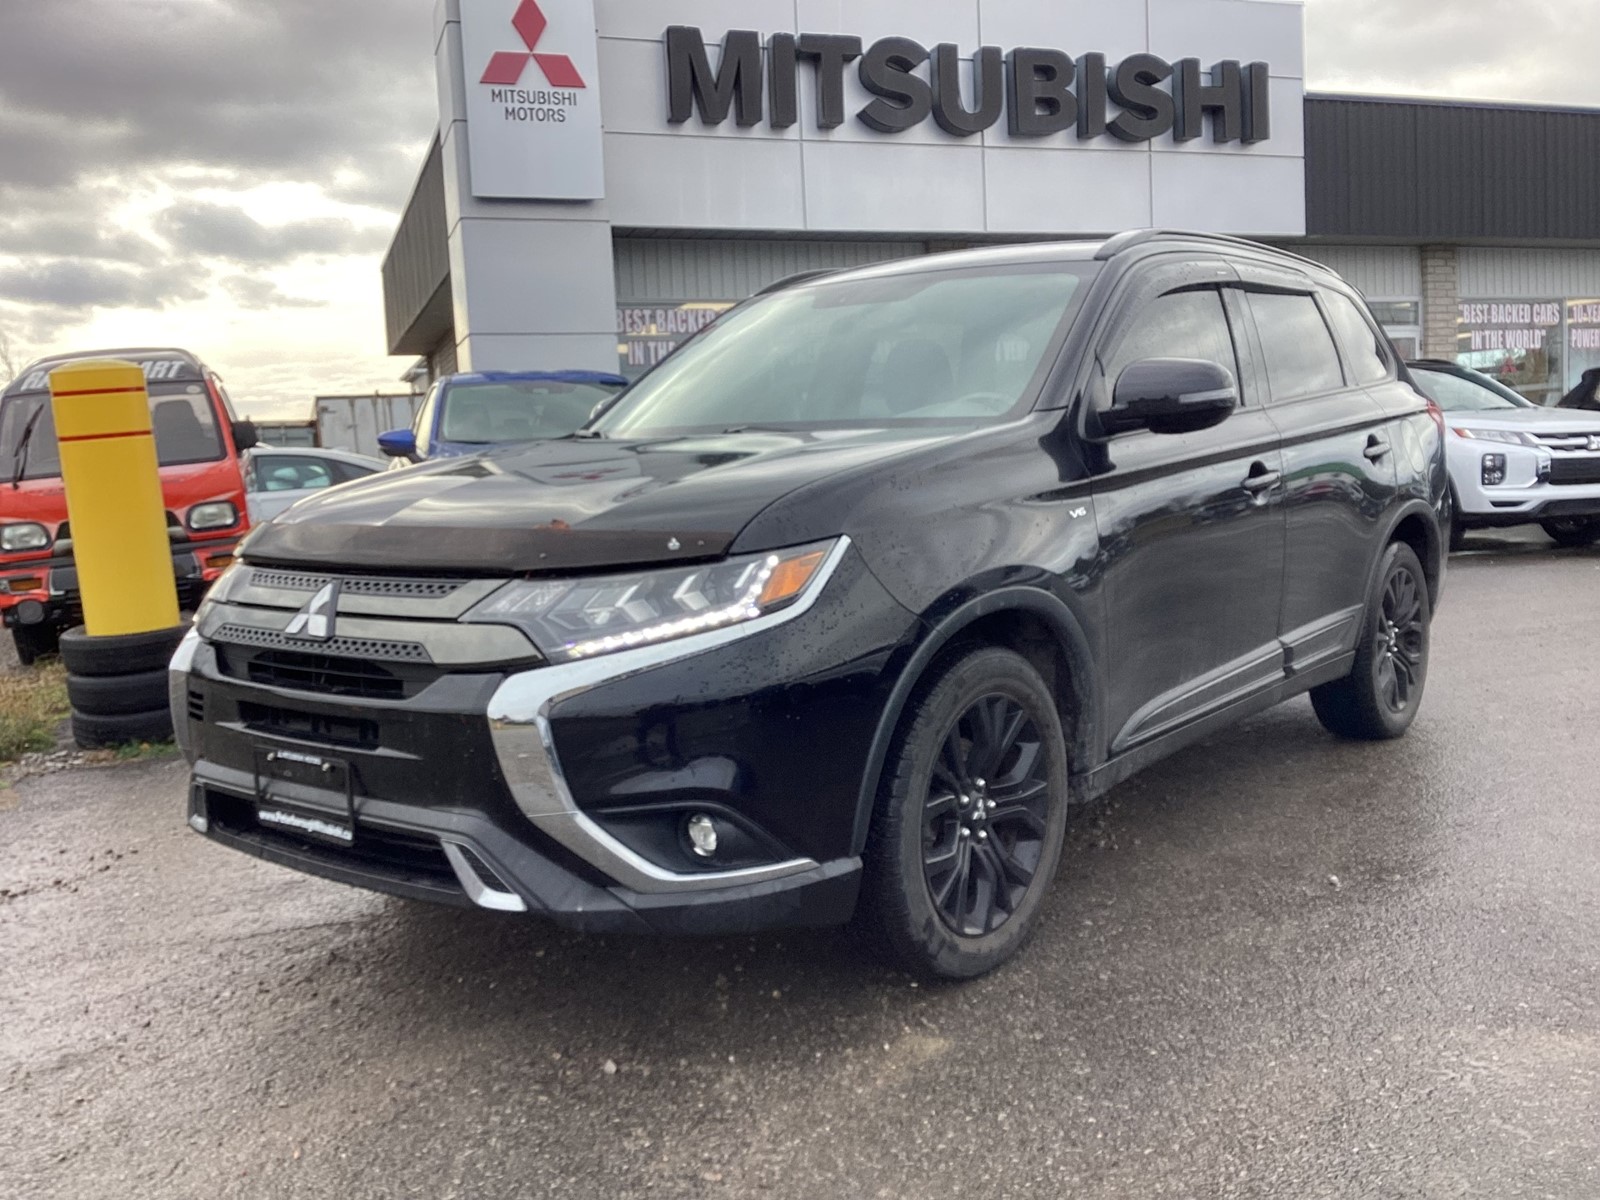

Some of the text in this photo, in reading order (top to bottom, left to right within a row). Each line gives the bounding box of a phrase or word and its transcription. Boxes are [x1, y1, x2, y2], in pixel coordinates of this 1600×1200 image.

[663, 24, 1270, 145] MITSUBISHI
[490, 88, 578, 106] MITSUBISHI
[504, 107, 566, 122] MOTORS
[1491, 303, 1531, 323] BACKED
[1533, 303, 1560, 323] CARS
[1471, 329, 1482, 350] IN
[1483, 329, 1503, 349] THE
[628, 341, 644, 365] IN
[1069, 506, 1087, 519] V6
